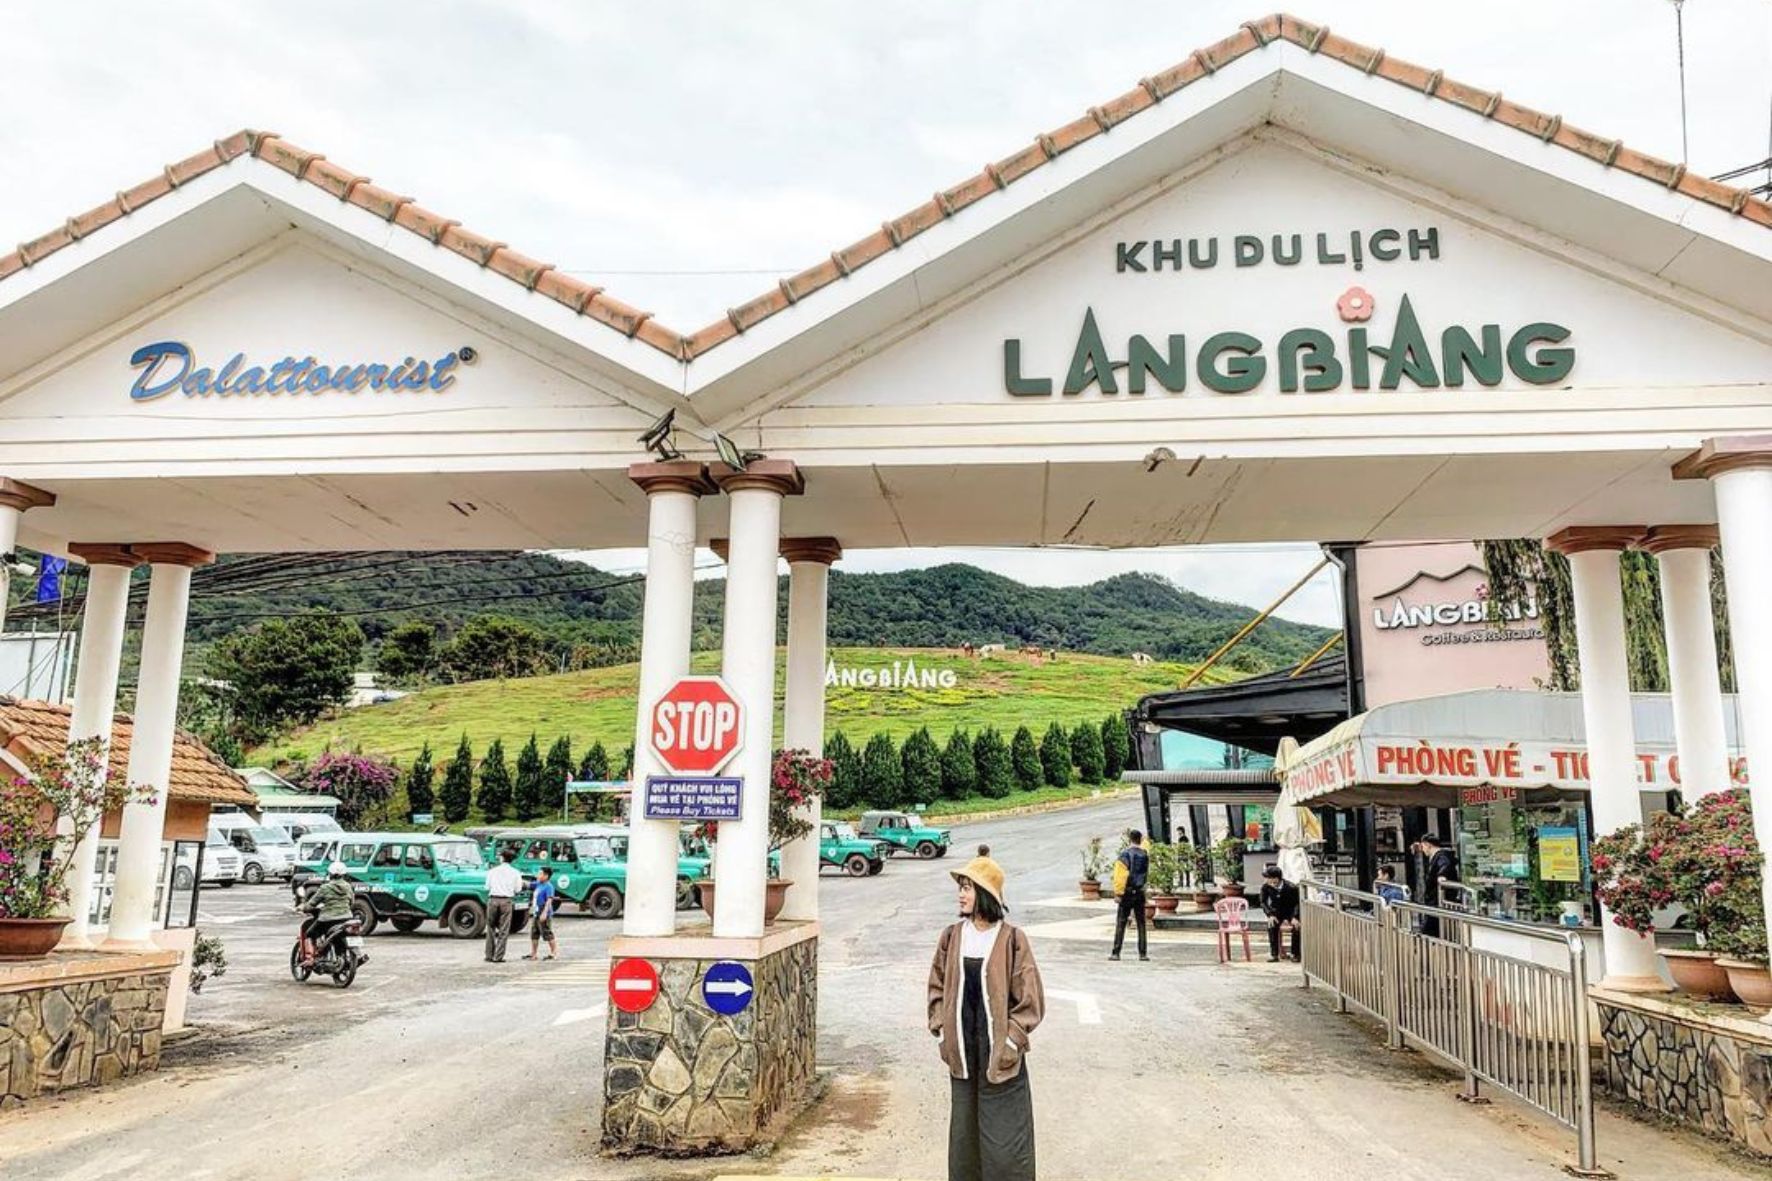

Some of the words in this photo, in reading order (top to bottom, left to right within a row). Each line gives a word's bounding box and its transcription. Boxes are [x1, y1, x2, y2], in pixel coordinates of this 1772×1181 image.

[1116, 236, 1217, 272] KHU
[1235, 234, 1301, 267] DU
[1317, 227, 1440, 271] LỊCH
[130, 341, 458, 402] Dalattourist
[825, 657, 957, 688] ANGBIANG
[655, 701, 737, 751] STOP
[1377, 739, 1477, 776] PHÒNG
[1483, 742, 1522, 778] VÉ
[650, 806, 681, 815] Please
[682, 806, 700, 817] Buy
[703, 806, 735, 816] Tickets
